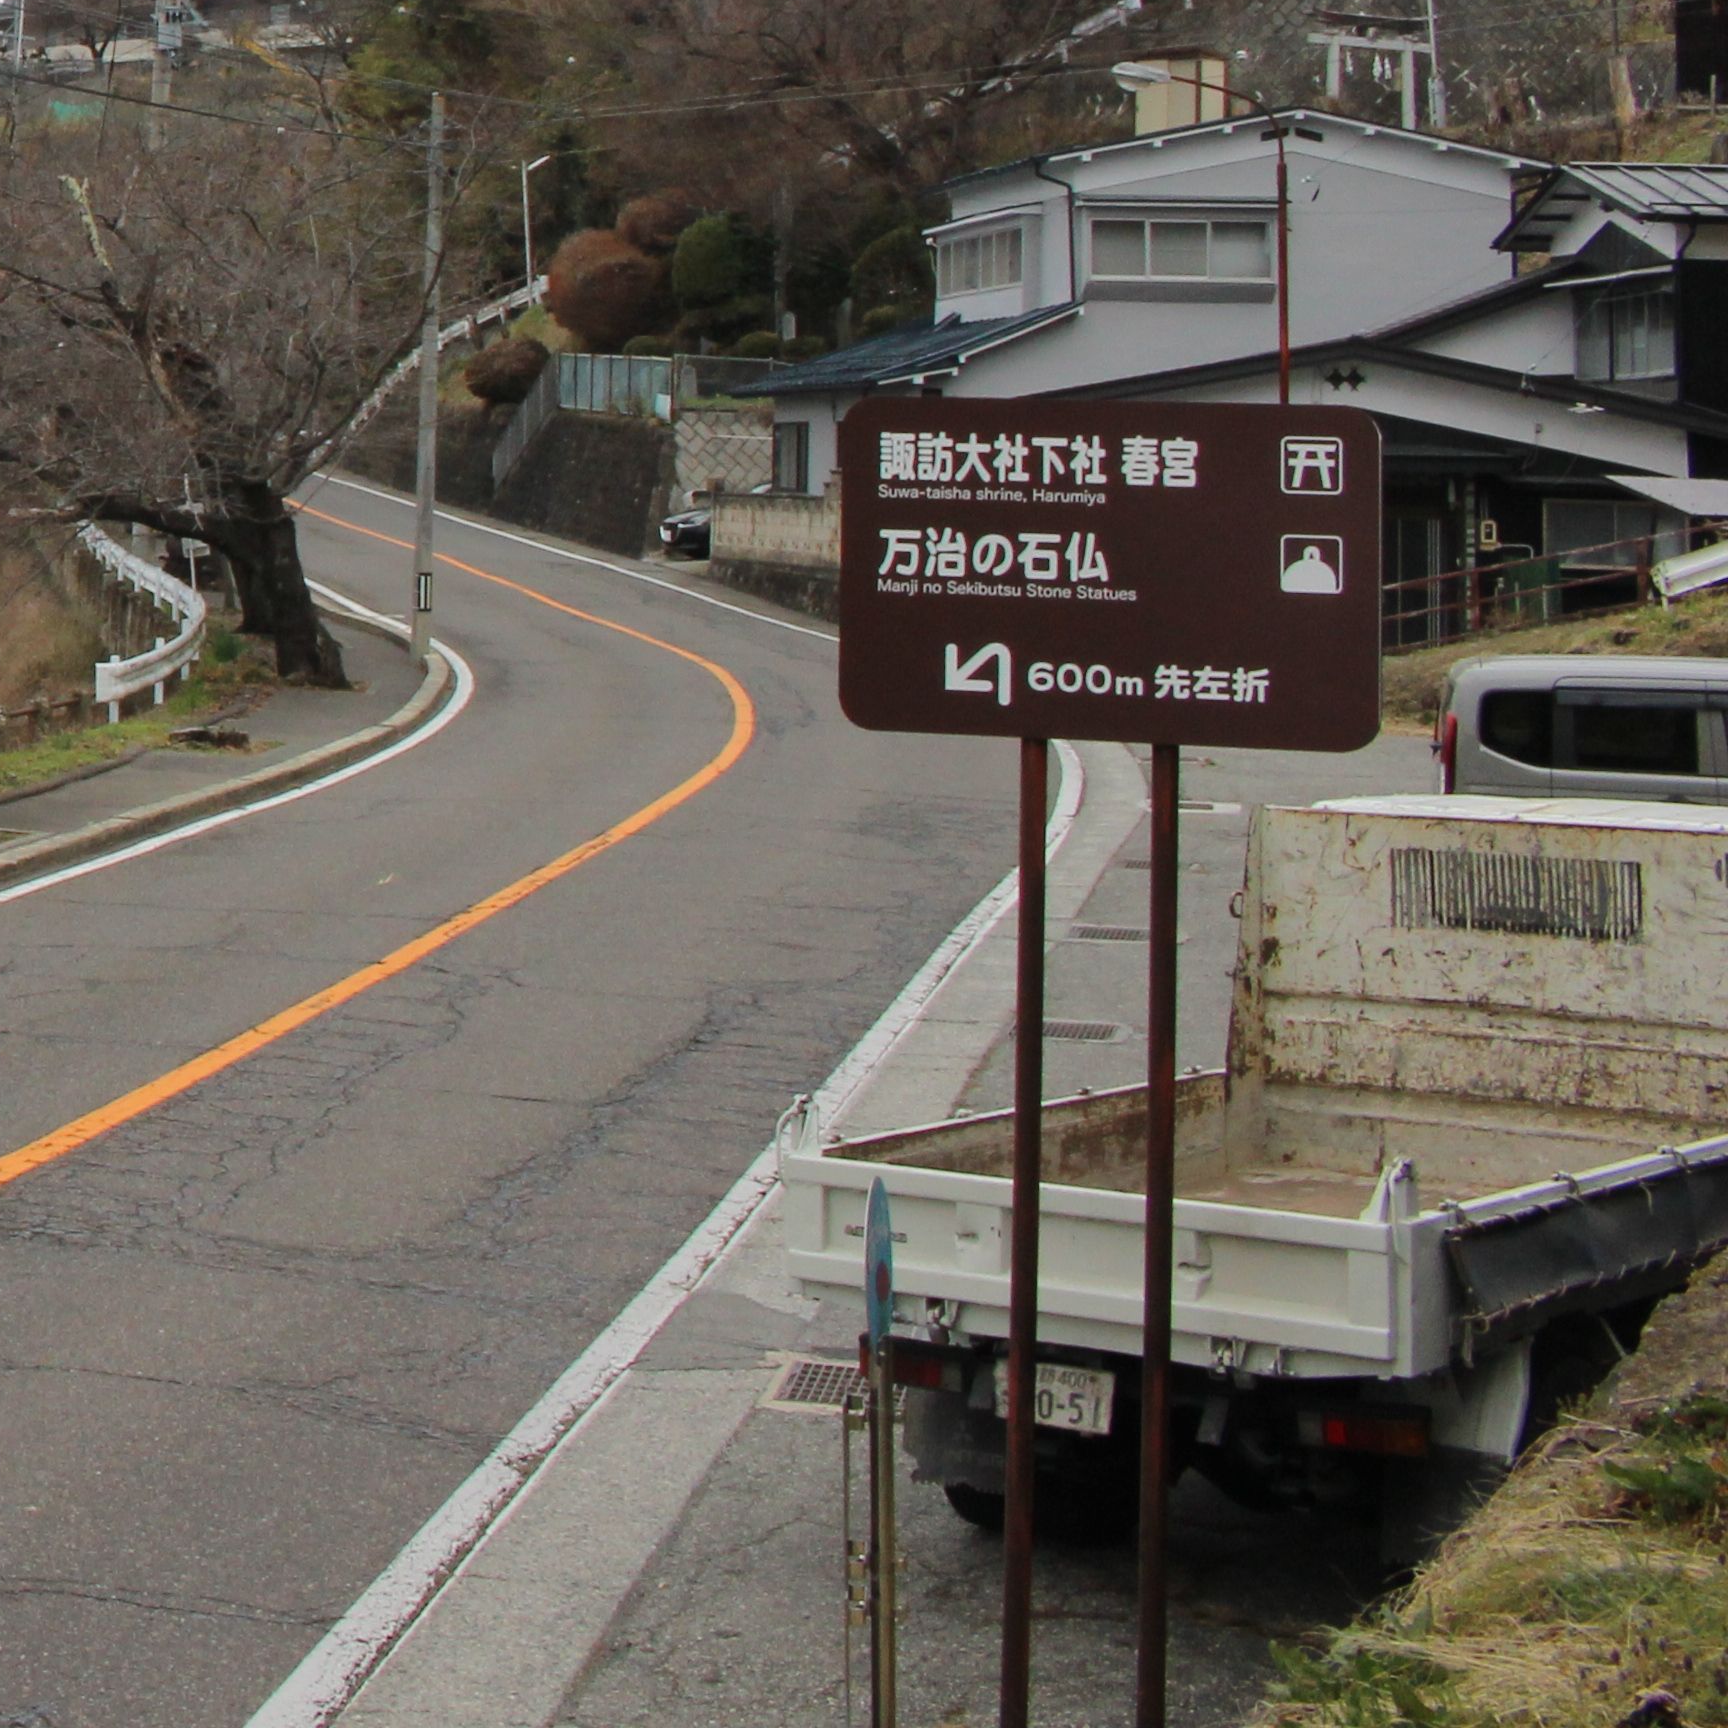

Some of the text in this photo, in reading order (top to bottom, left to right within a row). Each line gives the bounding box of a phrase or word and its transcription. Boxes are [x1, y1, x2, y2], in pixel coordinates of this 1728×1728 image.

[879, 431, 1199, 488] 諏訪大社下社 春宮
[877, 483, 1106, 507] Suwa-taisha shrine, Harumiya
[877, 527, 1110, 583] 万治の石仏
[876, 578, 1138, 602] Manji no Sekibutsu Stone Statues
[1027, 661, 1270, 704] 600m 先左折
[1037, 1388, 1101, 1429] 0-51
